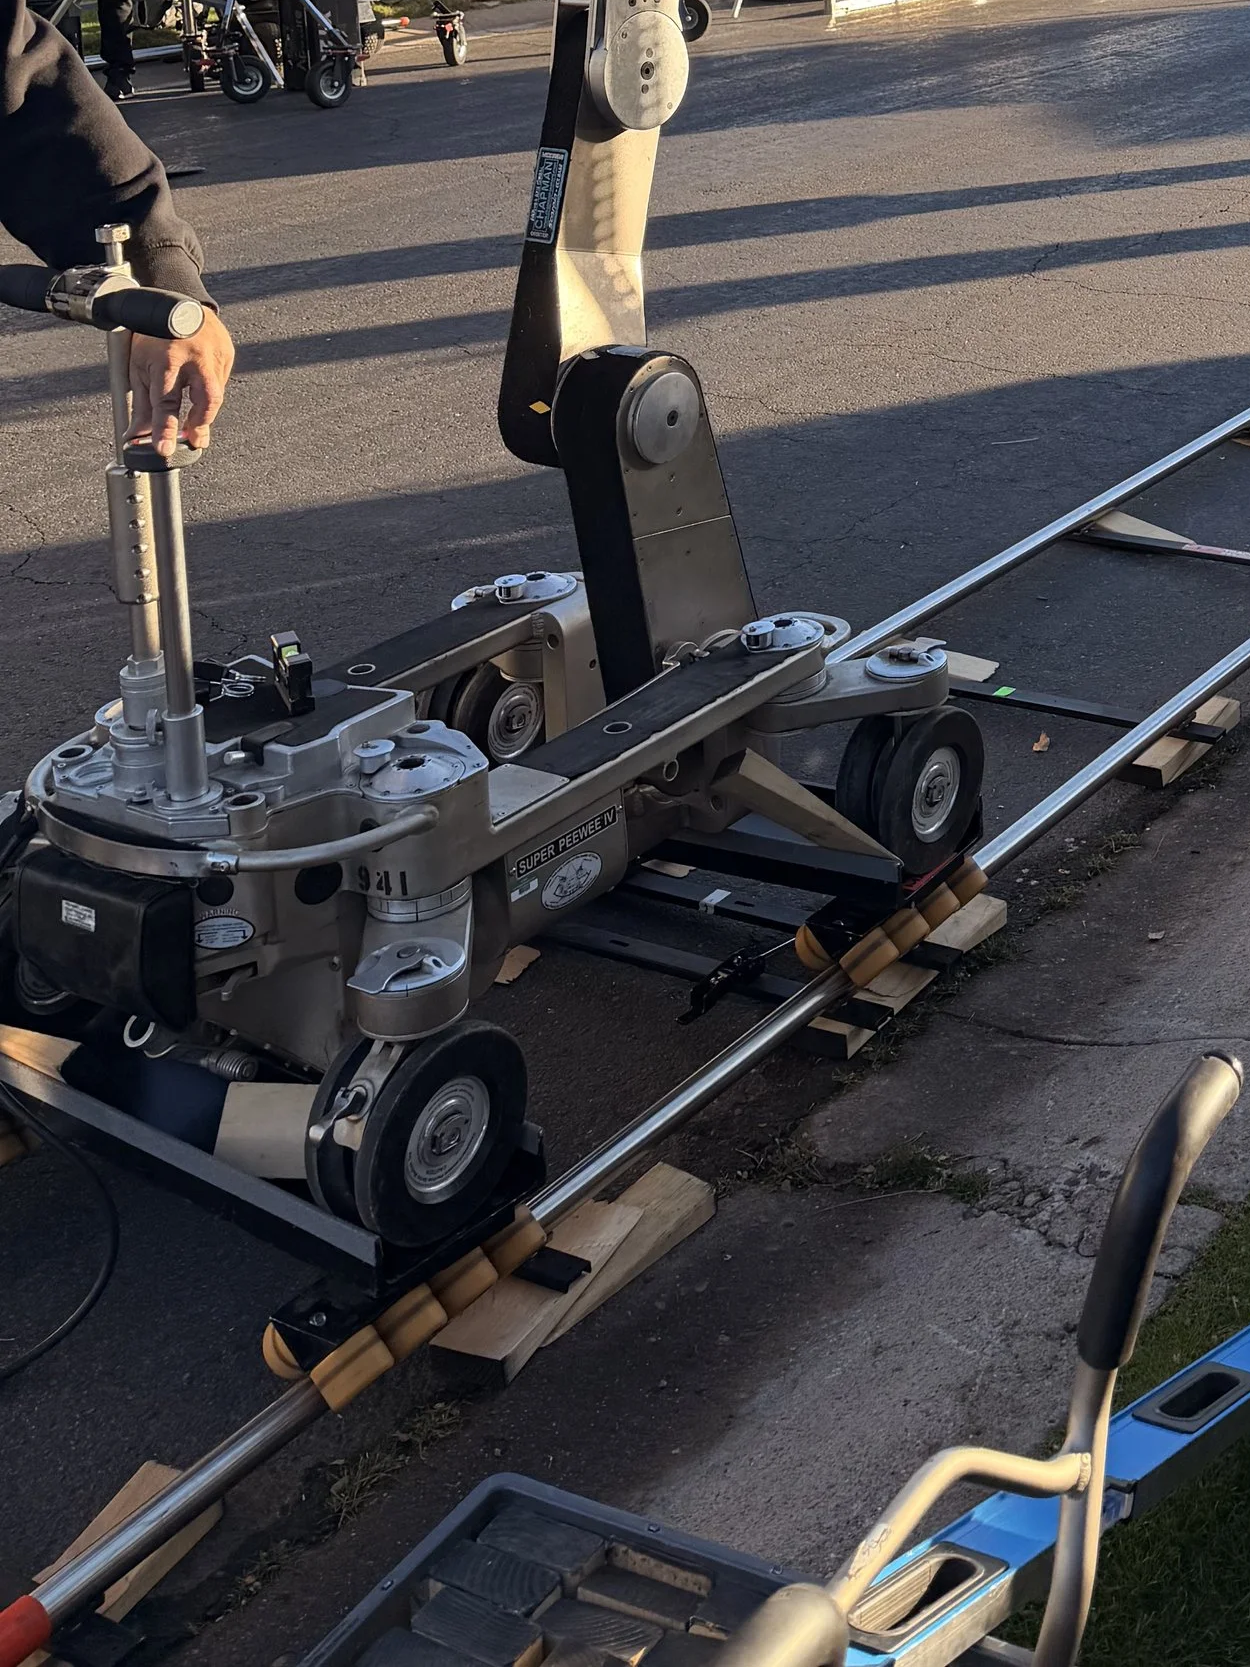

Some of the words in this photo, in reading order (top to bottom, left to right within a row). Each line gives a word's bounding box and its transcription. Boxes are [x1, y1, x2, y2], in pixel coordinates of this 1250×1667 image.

[534, 161, 553, 229] CHAPMAN
[519, 844, 556, 874] SUPER
[559, 817, 602, 852] PEEWEE
[603, 809, 615, 826] IV
[357, 865, 408, 896] 941
